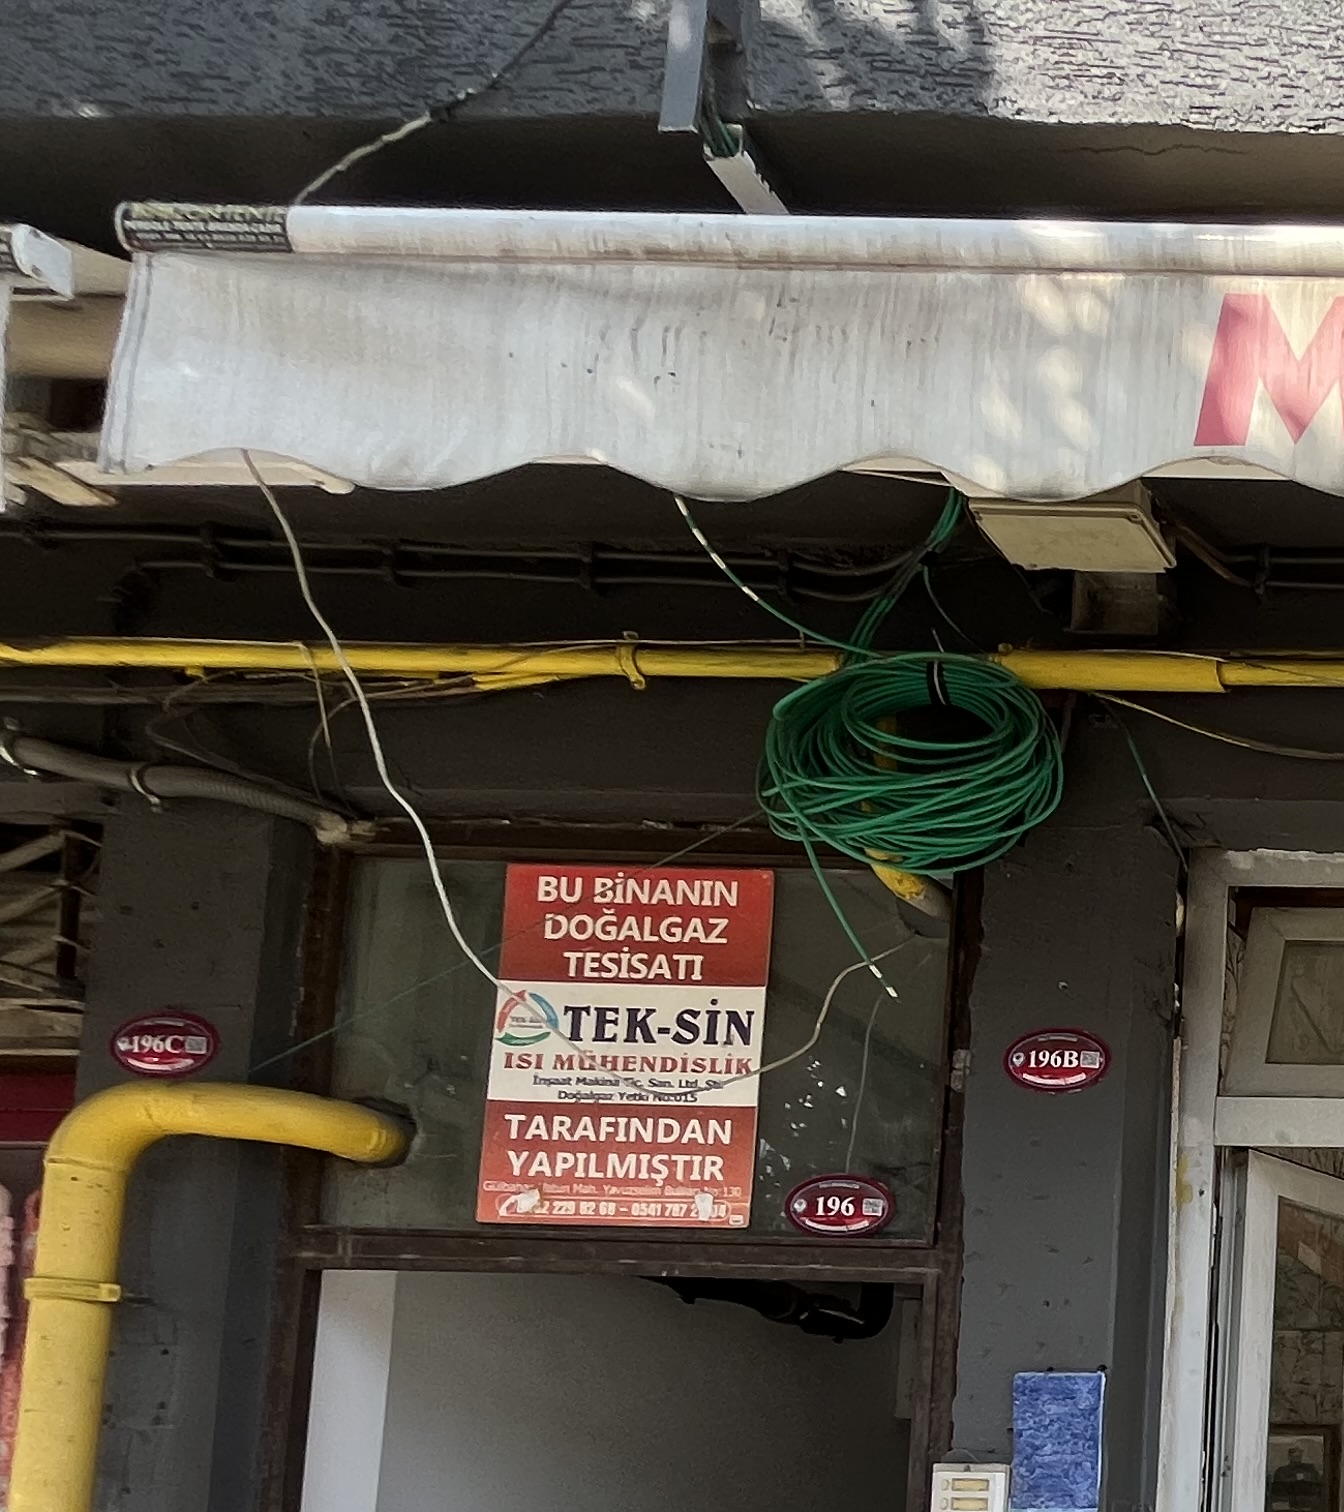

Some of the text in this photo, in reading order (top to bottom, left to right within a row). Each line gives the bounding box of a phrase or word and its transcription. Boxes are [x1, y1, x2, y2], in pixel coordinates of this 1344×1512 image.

[537, 872, 739, 908] BU BİNANIN
[543, 908, 729, 944] DOĞALGAZ
[562, 946, 705, 982] TESİSATI
[563, 998, 756, 1047] TEK-SİN
[132, 1034, 184, 1054] 196C
[1028, 1049, 1079, 1069] 196B
[503, 1049, 753, 1076] ISI MÜHENDİSLİK
[503, 1113, 732, 1145] TARAFINDAN
[506, 1149, 725, 1187] YAPILMIŞTIR
[815, 1195, 856, 1217] 196
